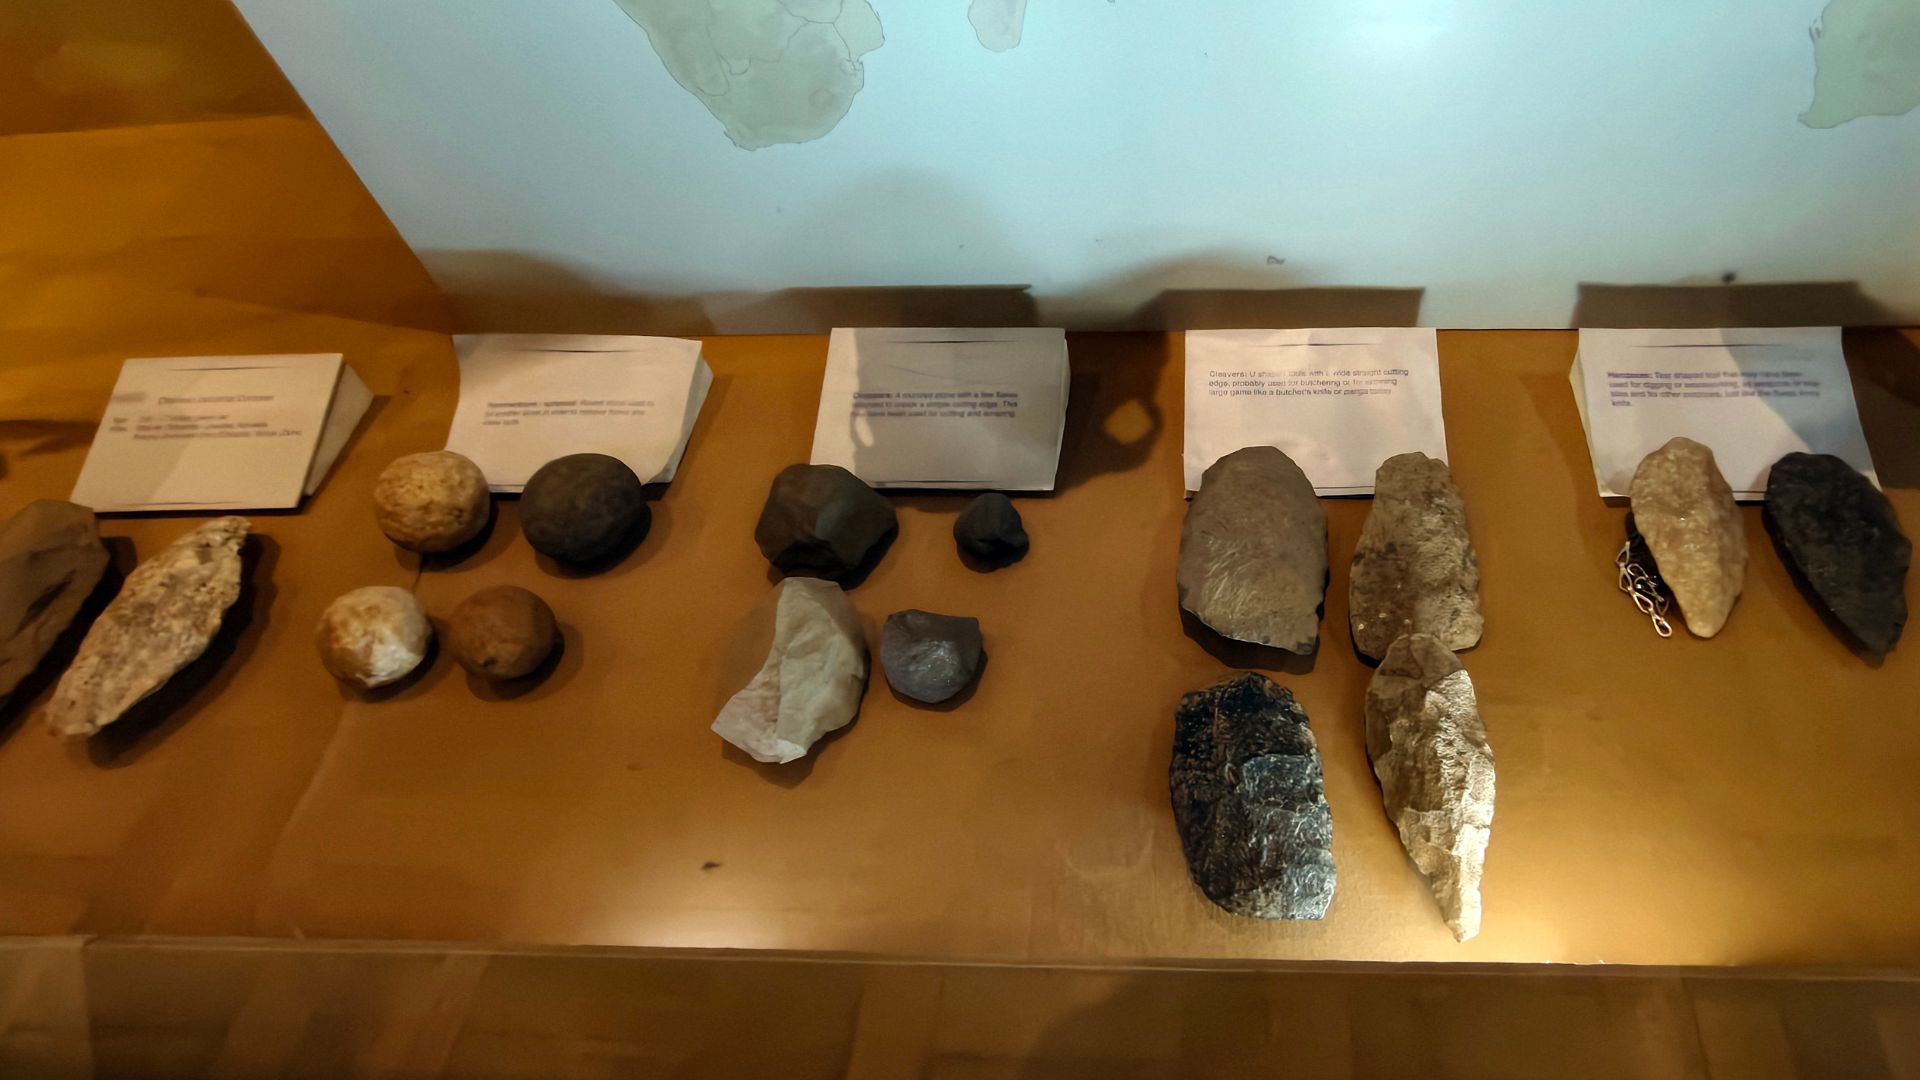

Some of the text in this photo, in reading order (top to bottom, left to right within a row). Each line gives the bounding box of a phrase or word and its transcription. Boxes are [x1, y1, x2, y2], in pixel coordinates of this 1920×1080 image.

[1352, 369, 1381, 378] straight
[1232, 380, 1265, 388] probably
[1230, 389, 1252, 397] game
[1253, 388, 1267, 396] like
